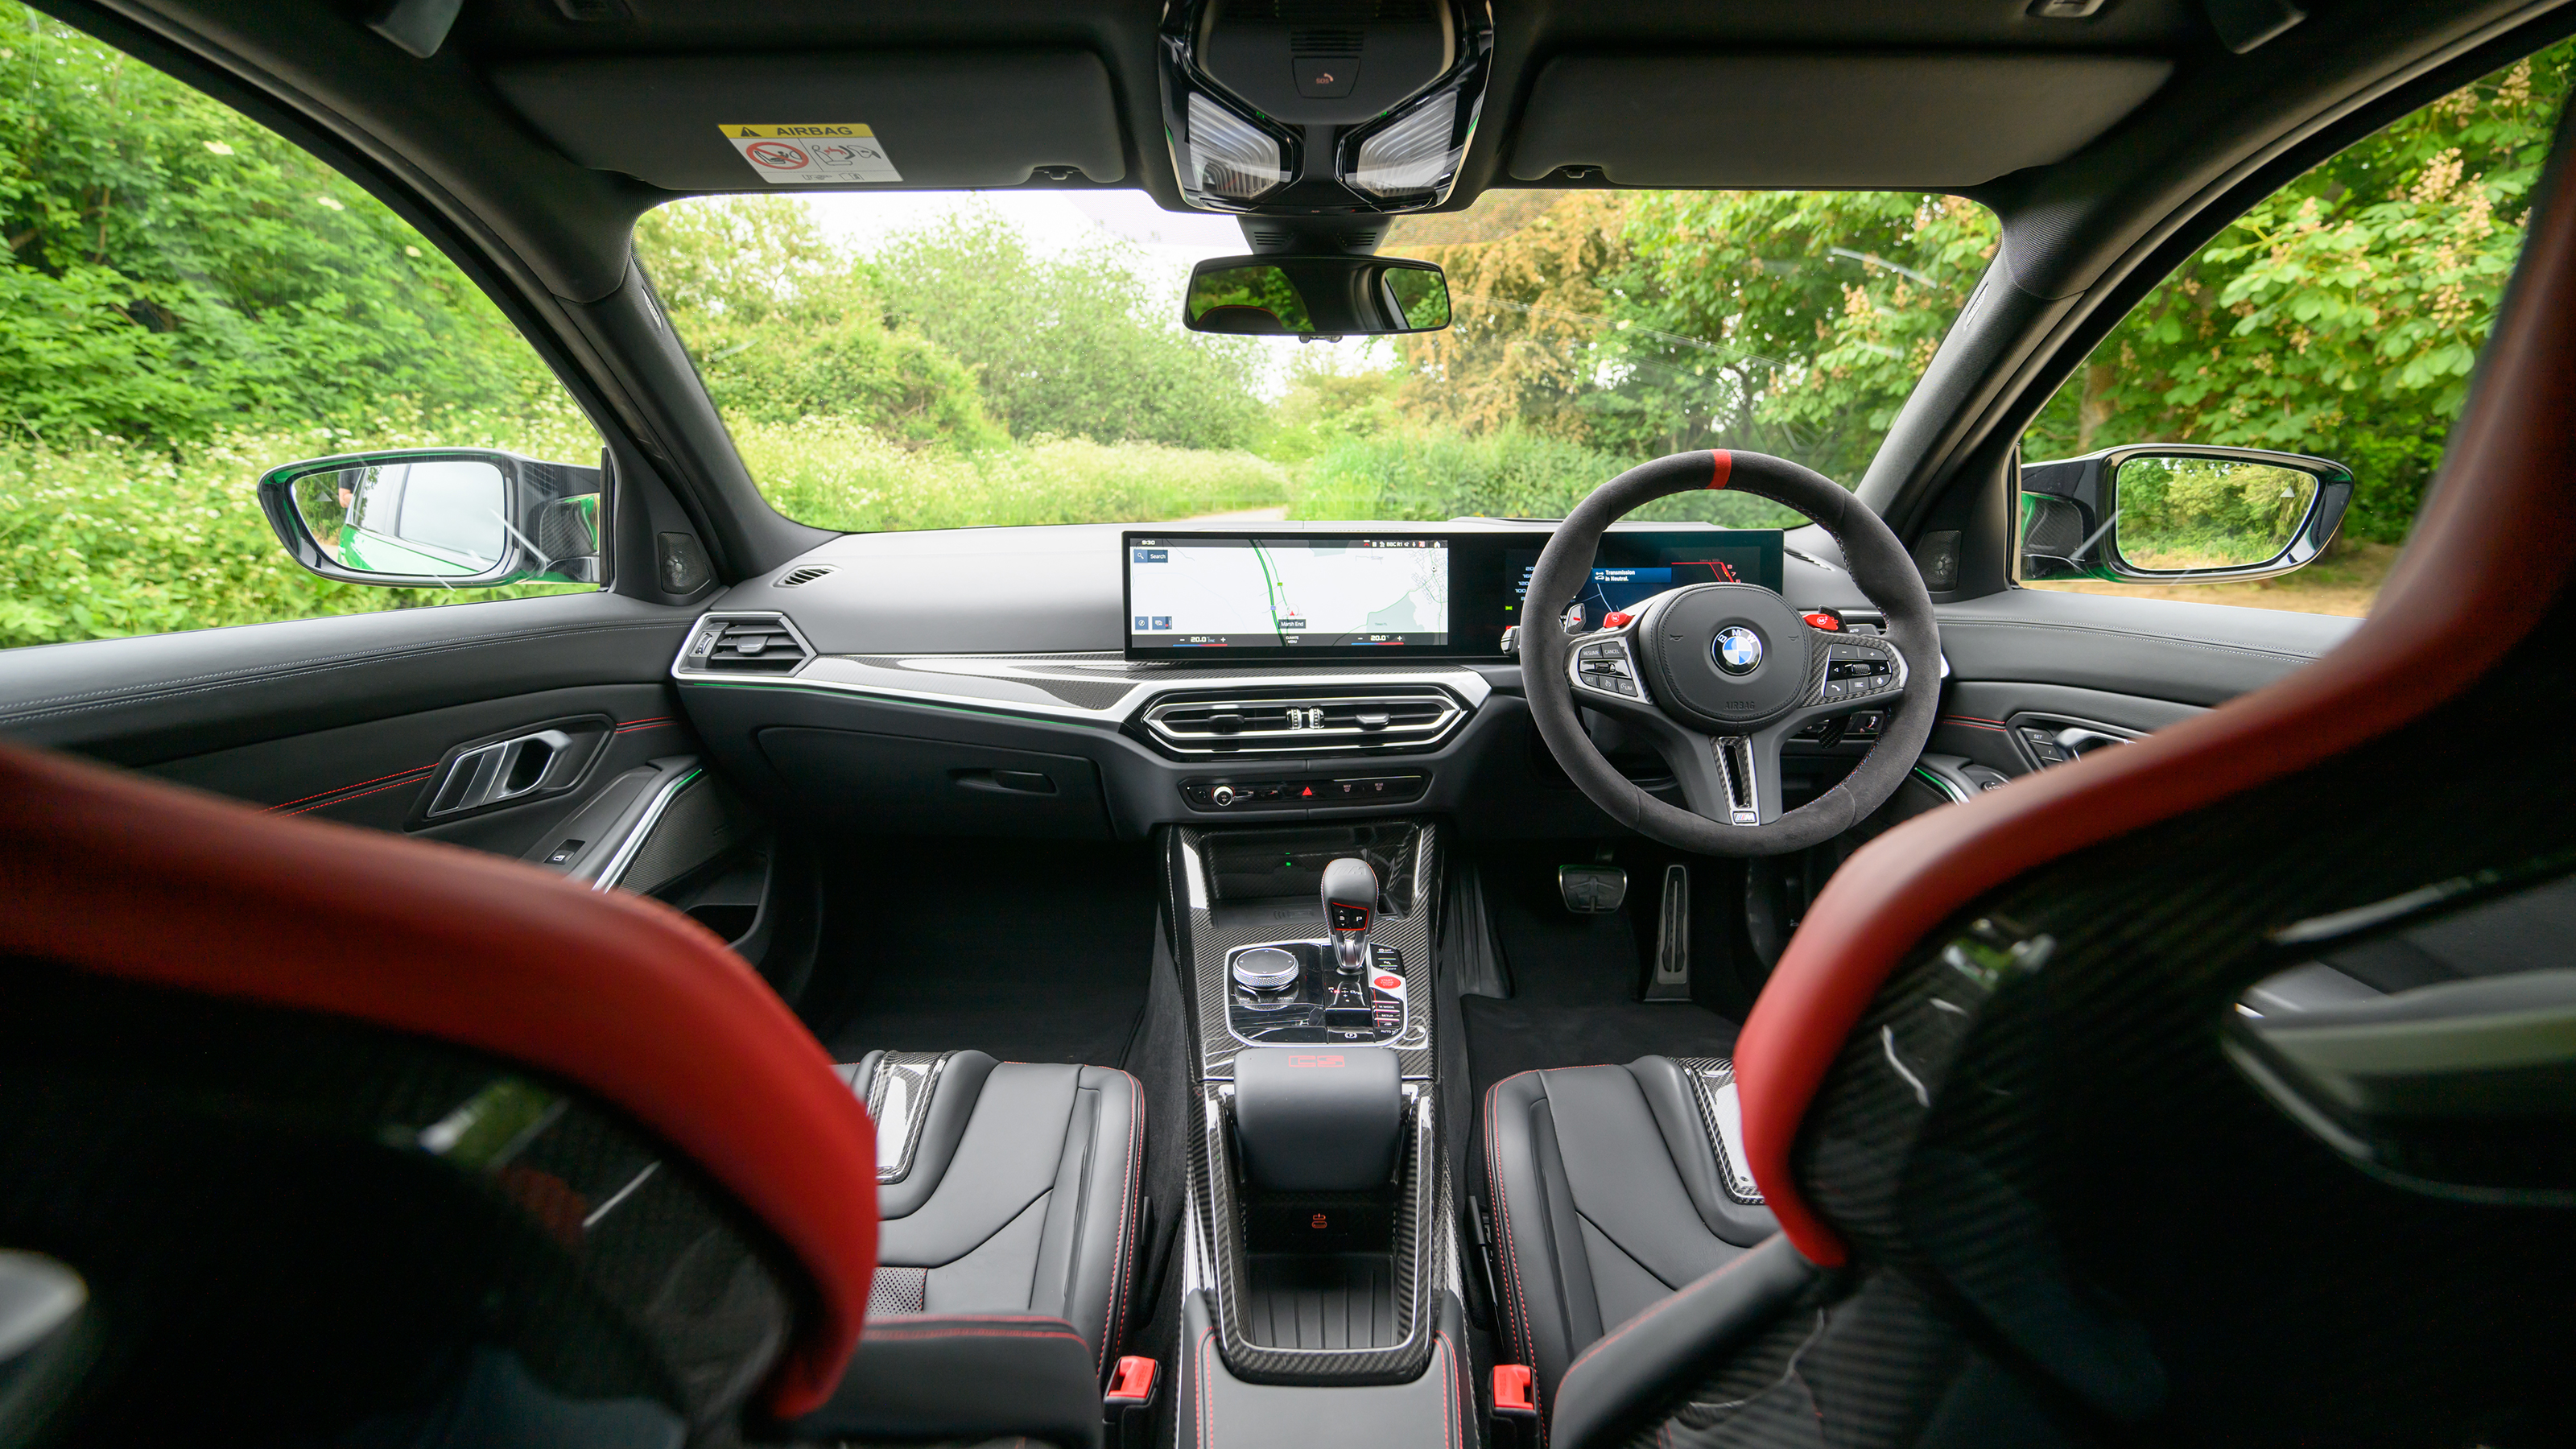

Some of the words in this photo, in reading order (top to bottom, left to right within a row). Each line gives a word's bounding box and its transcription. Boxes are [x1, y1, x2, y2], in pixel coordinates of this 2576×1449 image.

[777, 126, 853, 136] AIRBAG
[1717, 629, 1757, 644] BMW
[1724, 701, 1756, 711] AIRBAG
[1288, 1055, 1345, 1067] CS
